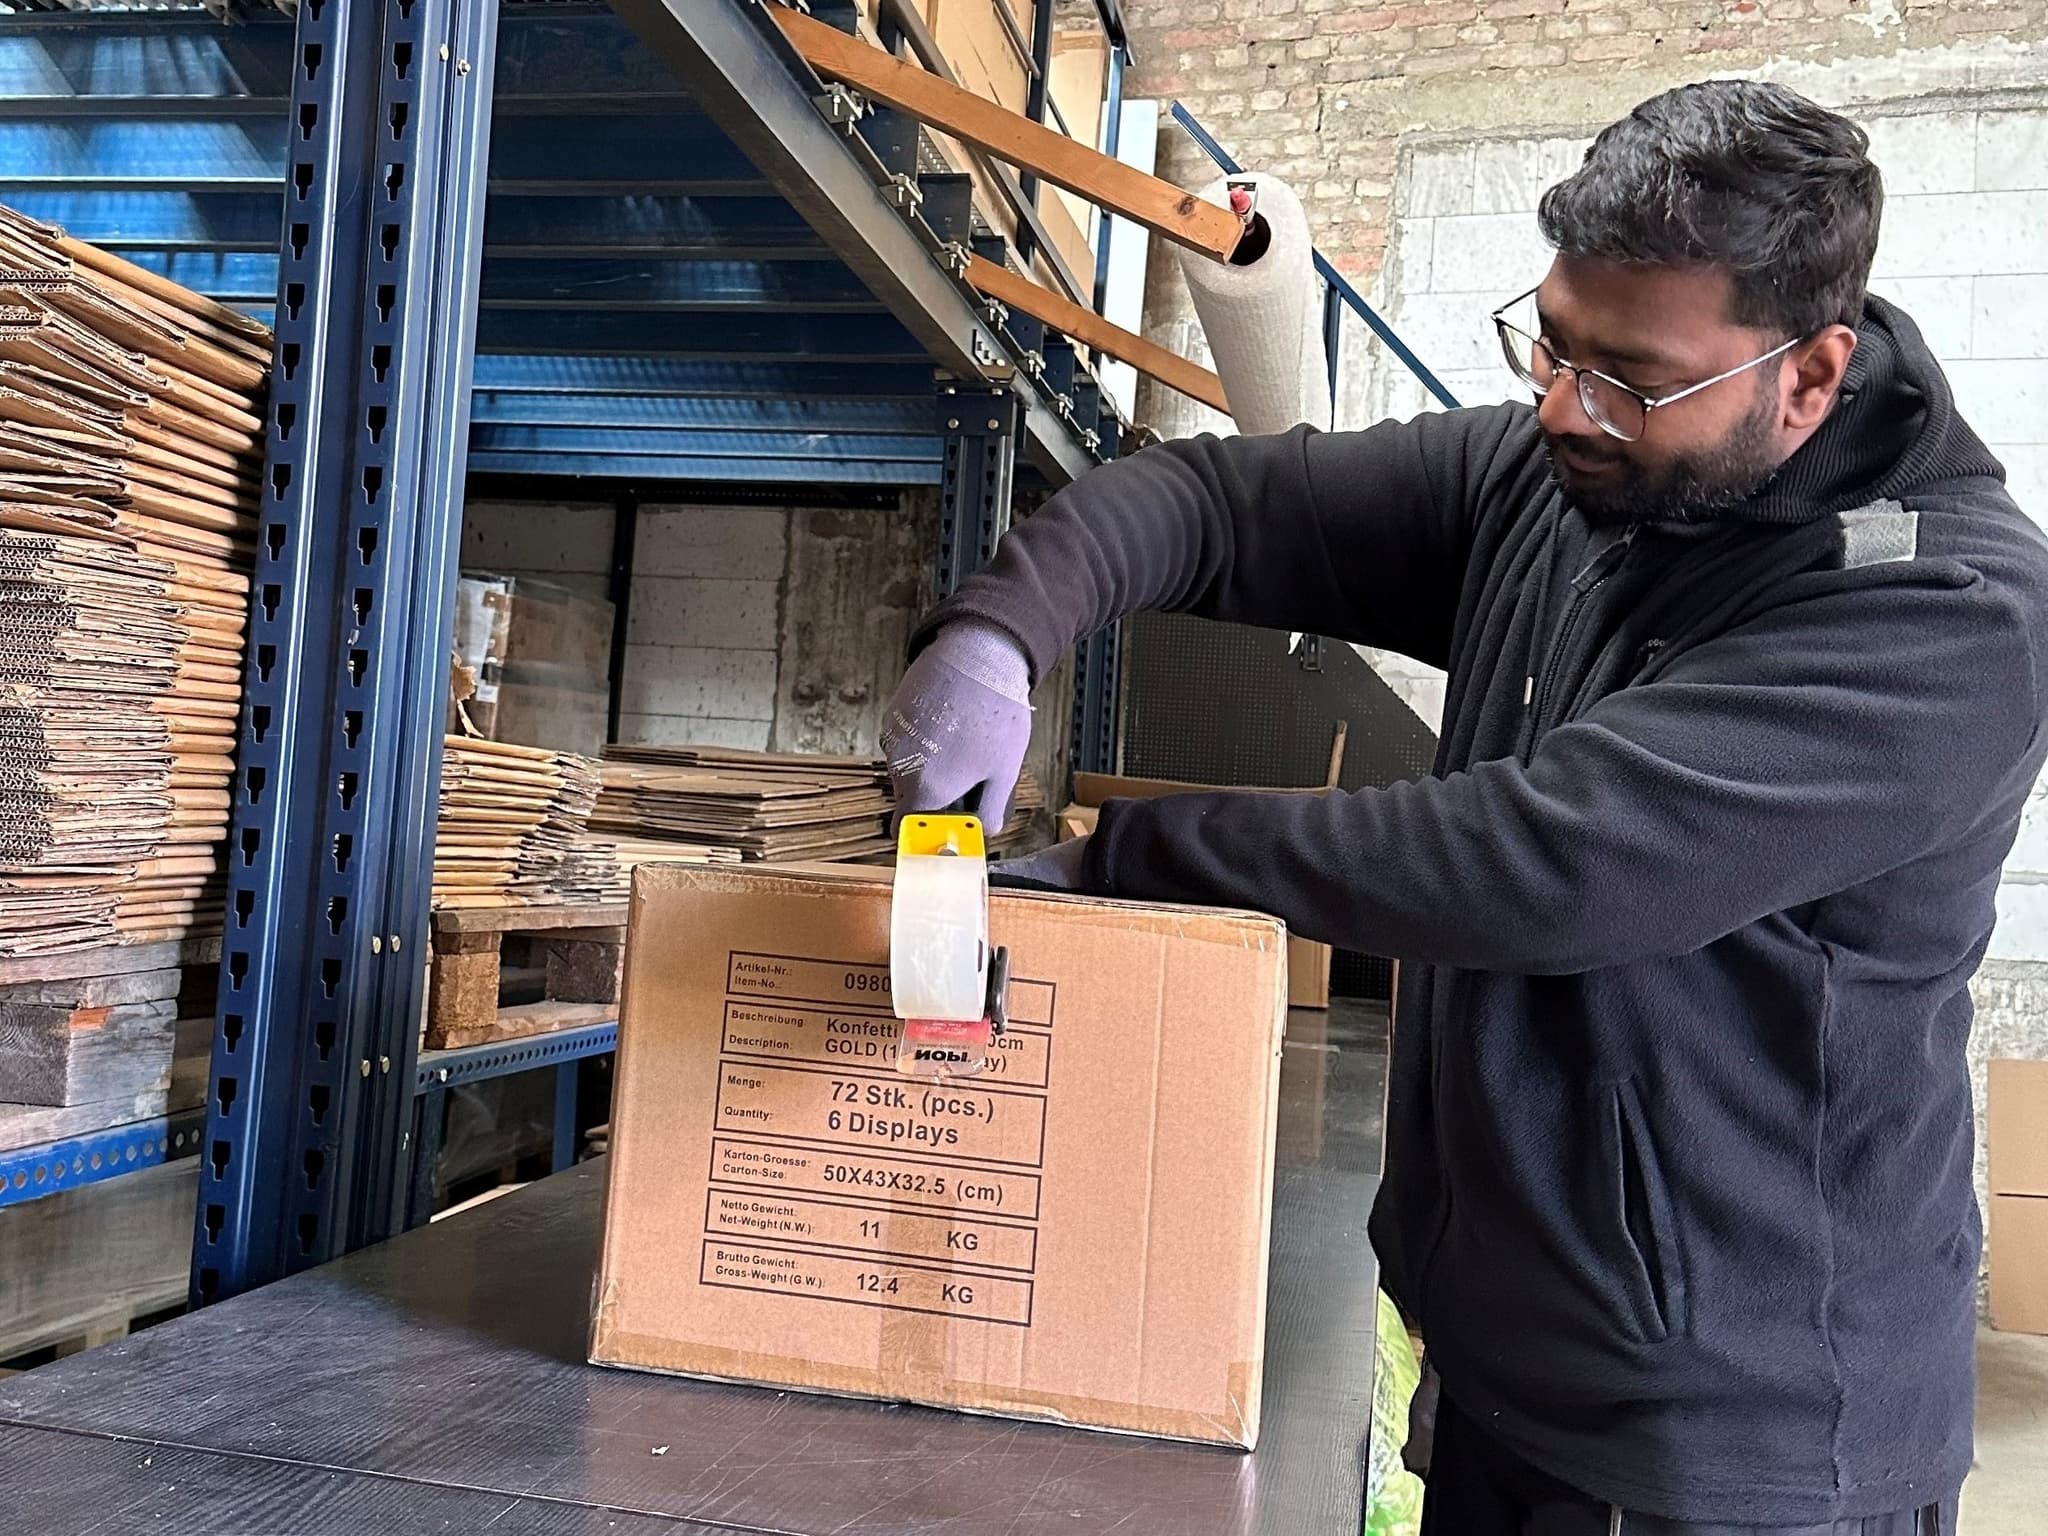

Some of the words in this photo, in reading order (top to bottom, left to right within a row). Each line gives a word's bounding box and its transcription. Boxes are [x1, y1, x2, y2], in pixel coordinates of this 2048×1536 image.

[826, 1018, 898, 1039] Konfetti
[987, 1033, 1024, 1051] 0cm
[825, 1038, 877, 1057] GOLD
[983, 1055, 1007, 1073] ay)
[727, 1075, 765, 1089] Menge:
[724, 1106, 774, 1121] Quantity:
[830, 1080, 859, 1103] 72
[865, 1085, 914, 1110] Stk.
[921, 1090, 995, 1124] (pcs.)
[828, 1110, 842, 1130] 6
[848, 1112, 959, 1147] Displays
[724, 1148, 811, 1168] Karton-Groesse:
[823, 1164, 946, 1195] 50X43X32.5
[956, 1180, 1003, 1207] (cm)
[720, 1199, 749, 1211] Netto
[719, 1213, 778, 1230] Net-Weight
[859, 1220, 880, 1239] 11
[946, 1230, 979, 1251] KG
[716, 1250, 750, 1263] Brutto
[715, 1265, 787, 1284] Gross-Weight
[857, 1273, 899, 1295] 12.4
[941, 1283, 974, 1304] KG
